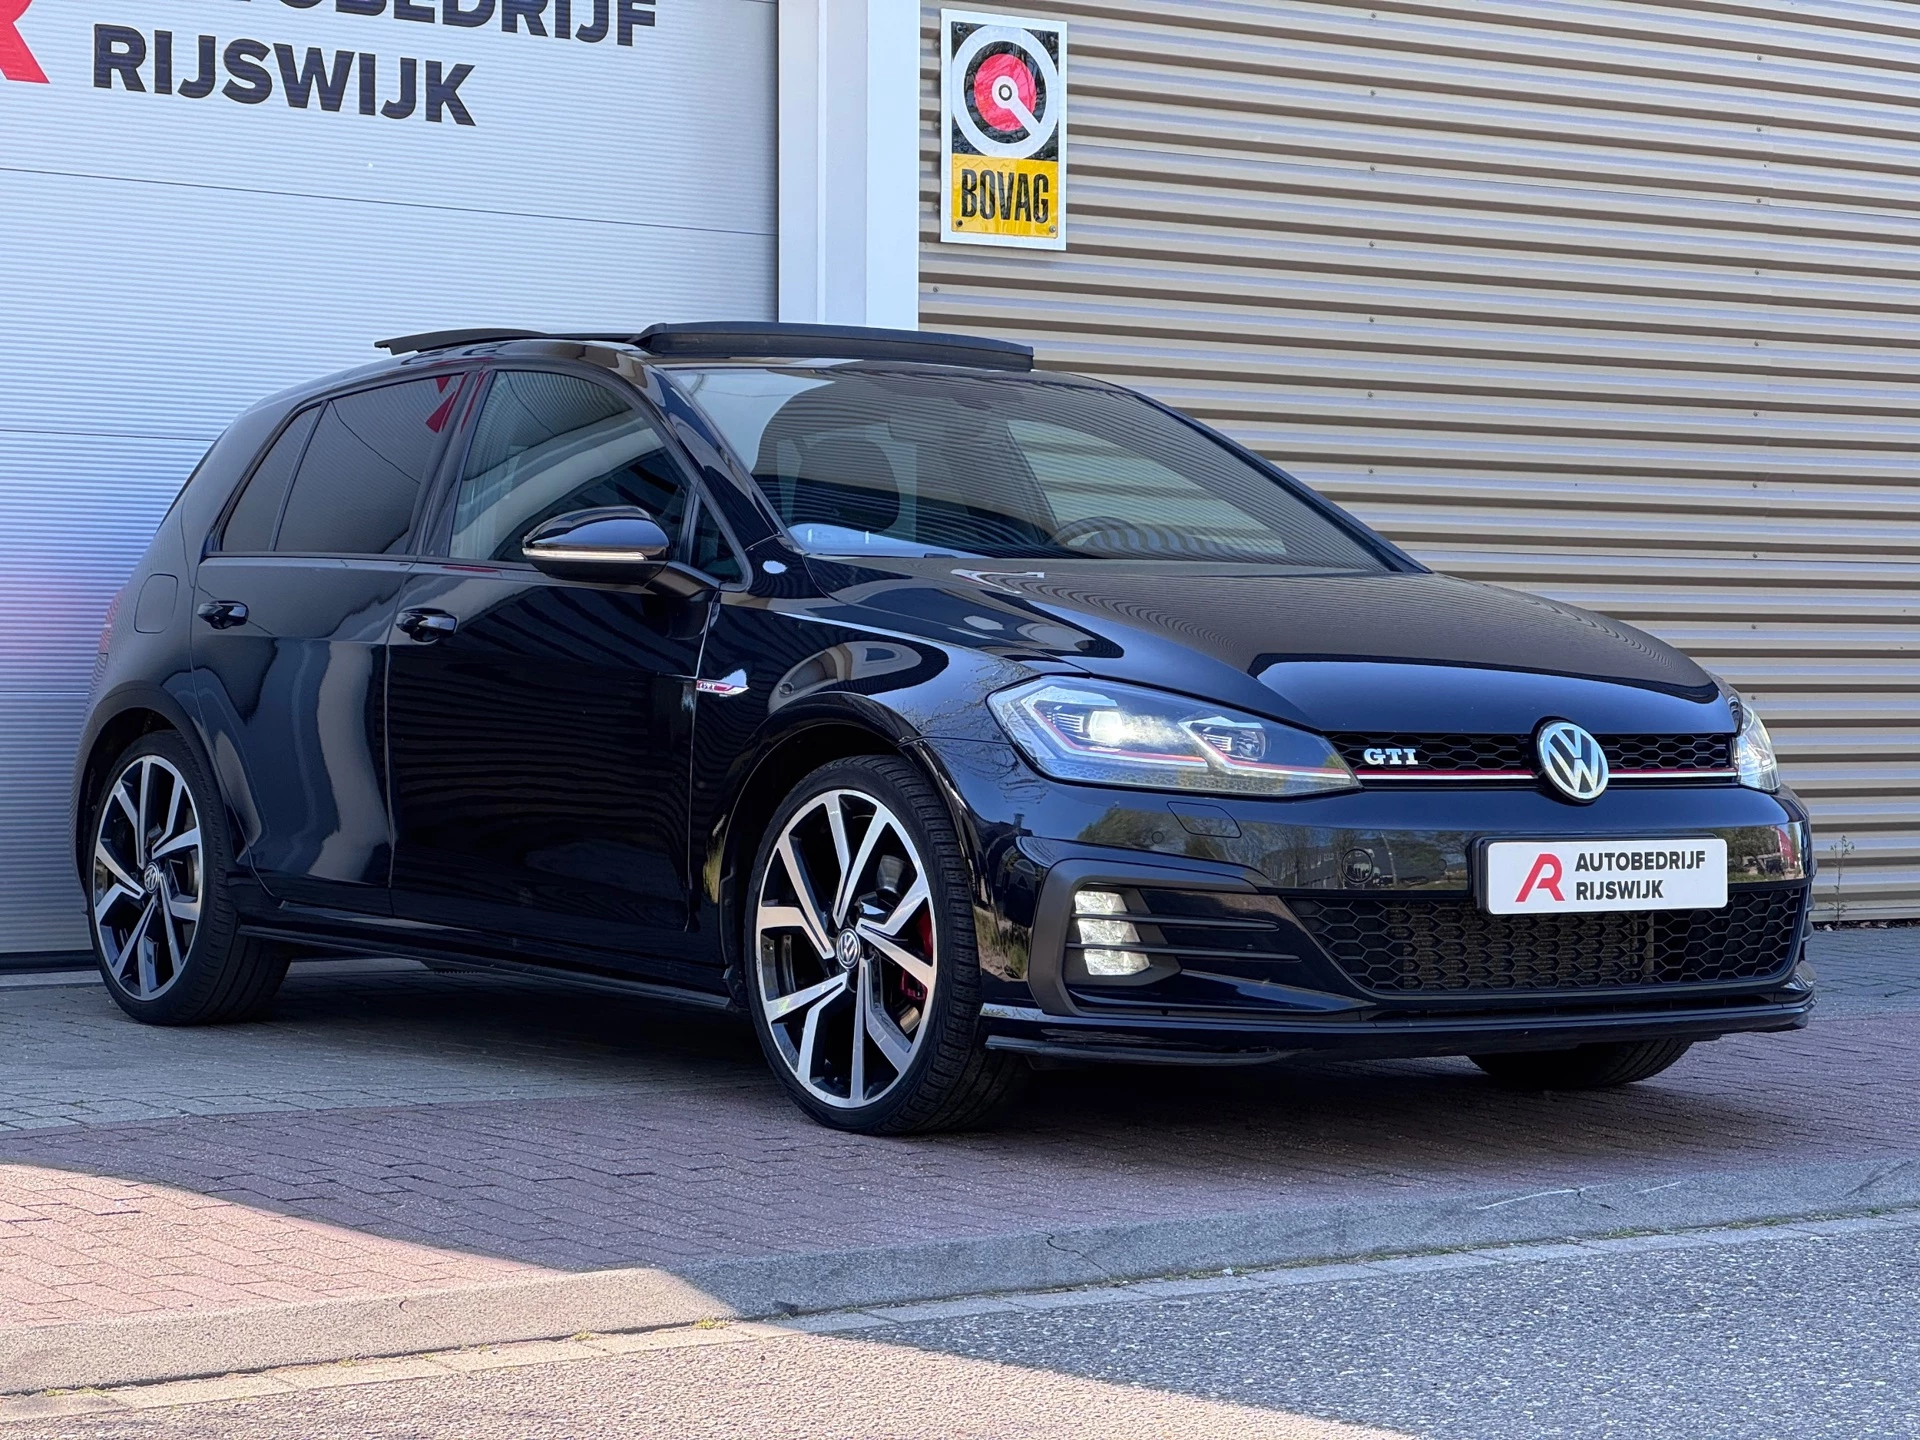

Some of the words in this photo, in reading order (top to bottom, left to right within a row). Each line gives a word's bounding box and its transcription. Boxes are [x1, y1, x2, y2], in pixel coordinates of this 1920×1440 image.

[93, 23, 476, 126] RIJSWIJK
[960, 168, 1049, 224] BOVAG
[1363, 748, 1419, 765] GTI
[1574, 850, 1706, 872] AUTOBEDRIJF
[1575, 879, 1664, 901] RIJSWIJK
